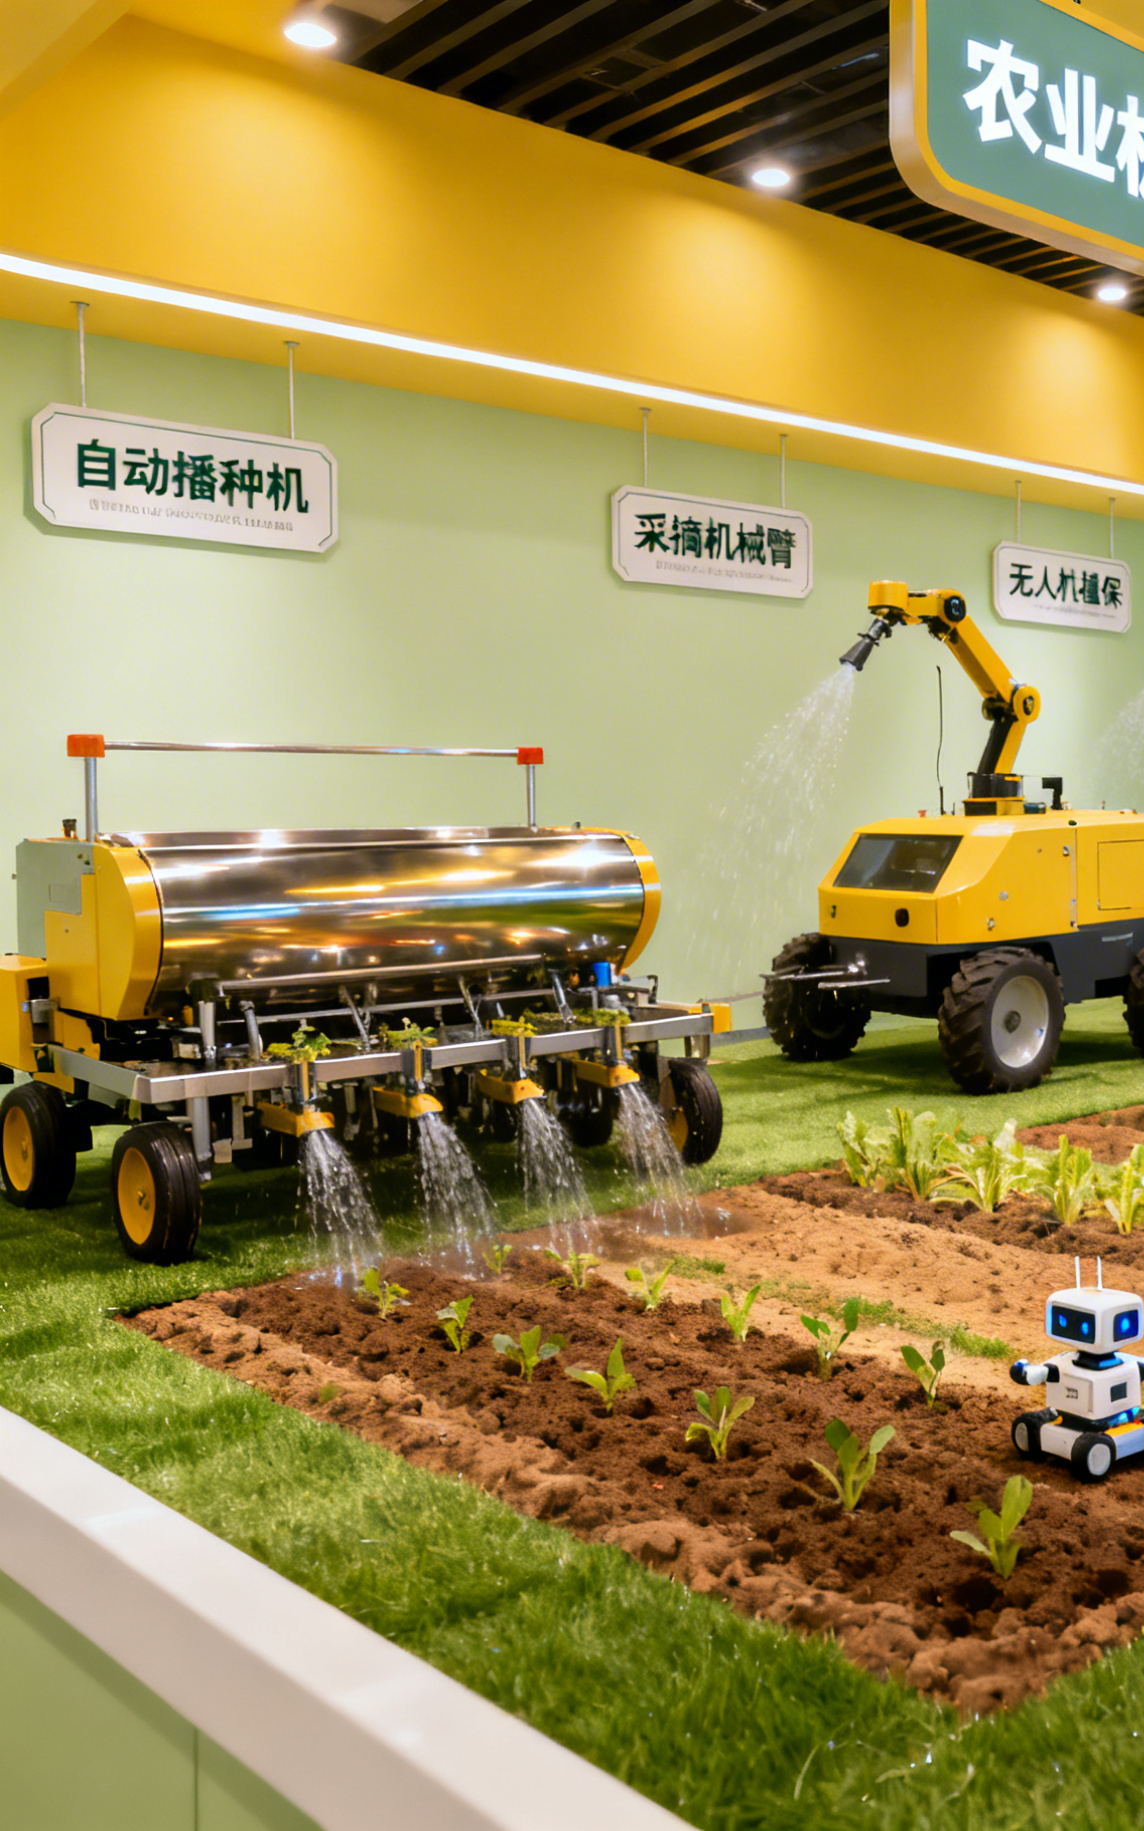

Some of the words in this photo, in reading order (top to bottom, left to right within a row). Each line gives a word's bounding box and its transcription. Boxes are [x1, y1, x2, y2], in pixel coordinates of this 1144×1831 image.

[77, 438, 309, 513] 自动播种机
